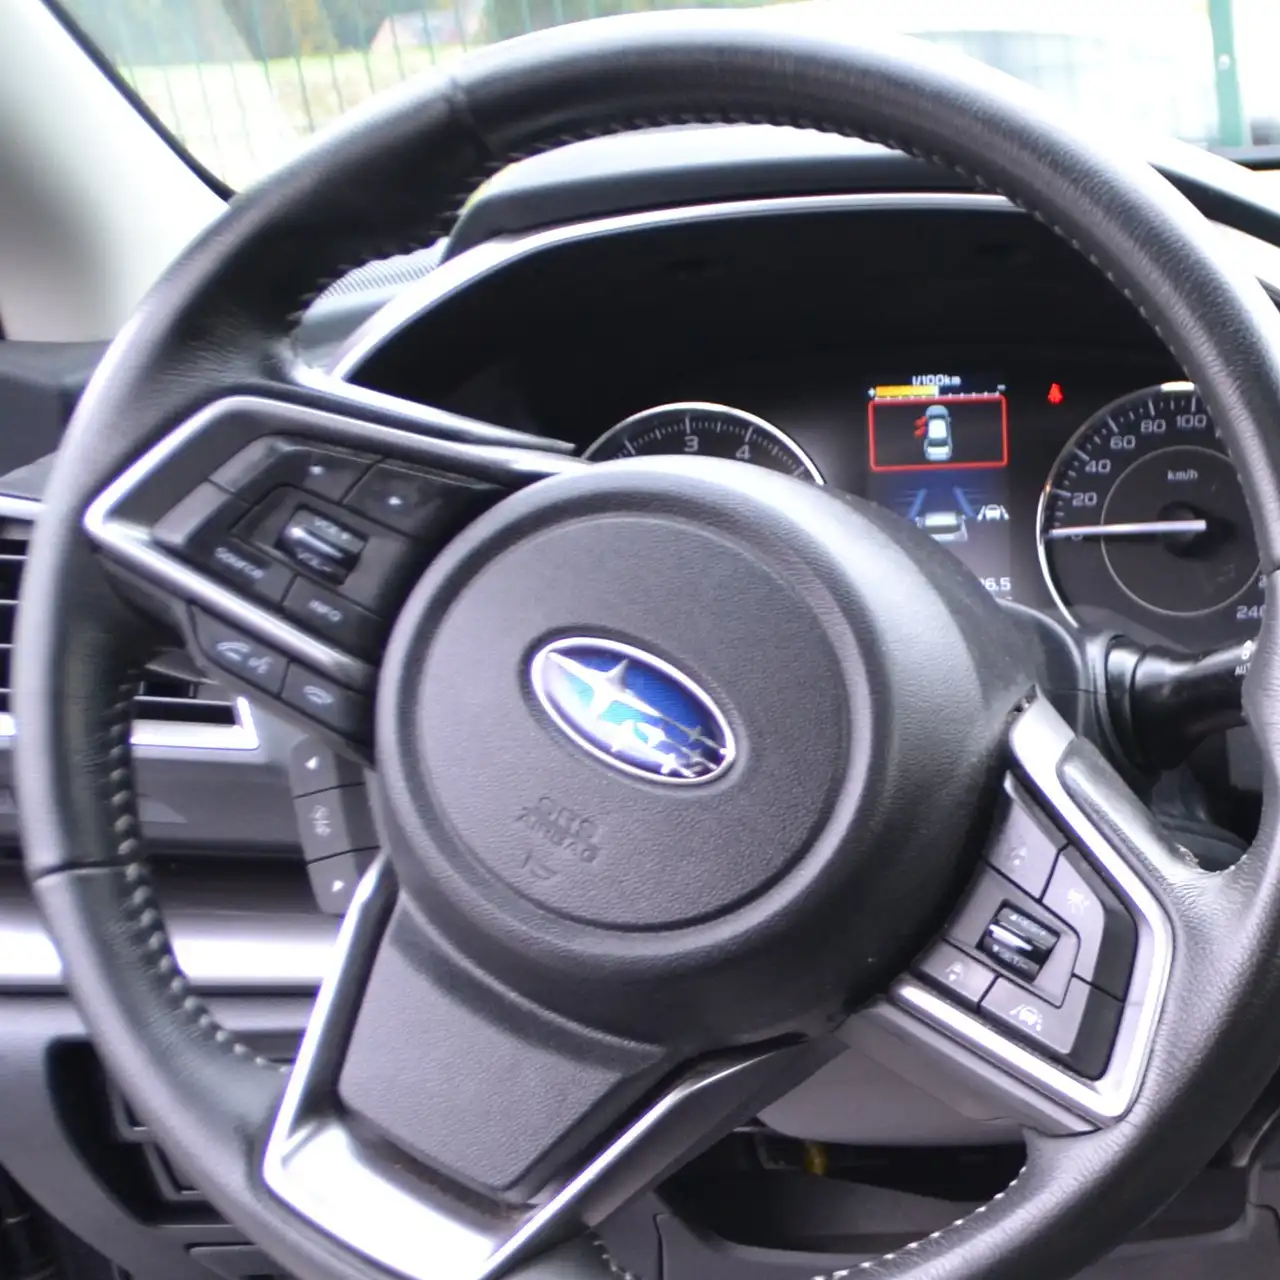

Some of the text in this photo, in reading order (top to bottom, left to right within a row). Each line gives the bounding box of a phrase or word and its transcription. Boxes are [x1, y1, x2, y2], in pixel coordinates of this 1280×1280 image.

[1140, 419, 1166, 433] 80
[1175, 414, 1207, 429] 100
[684, 436, 699, 452] 3
[1110, 435, 1136, 450] 60
[1085, 459, 1111, 474] 40
[1167, 469, 1198, 481] km/h
[1072, 492, 1097, 507] 20
